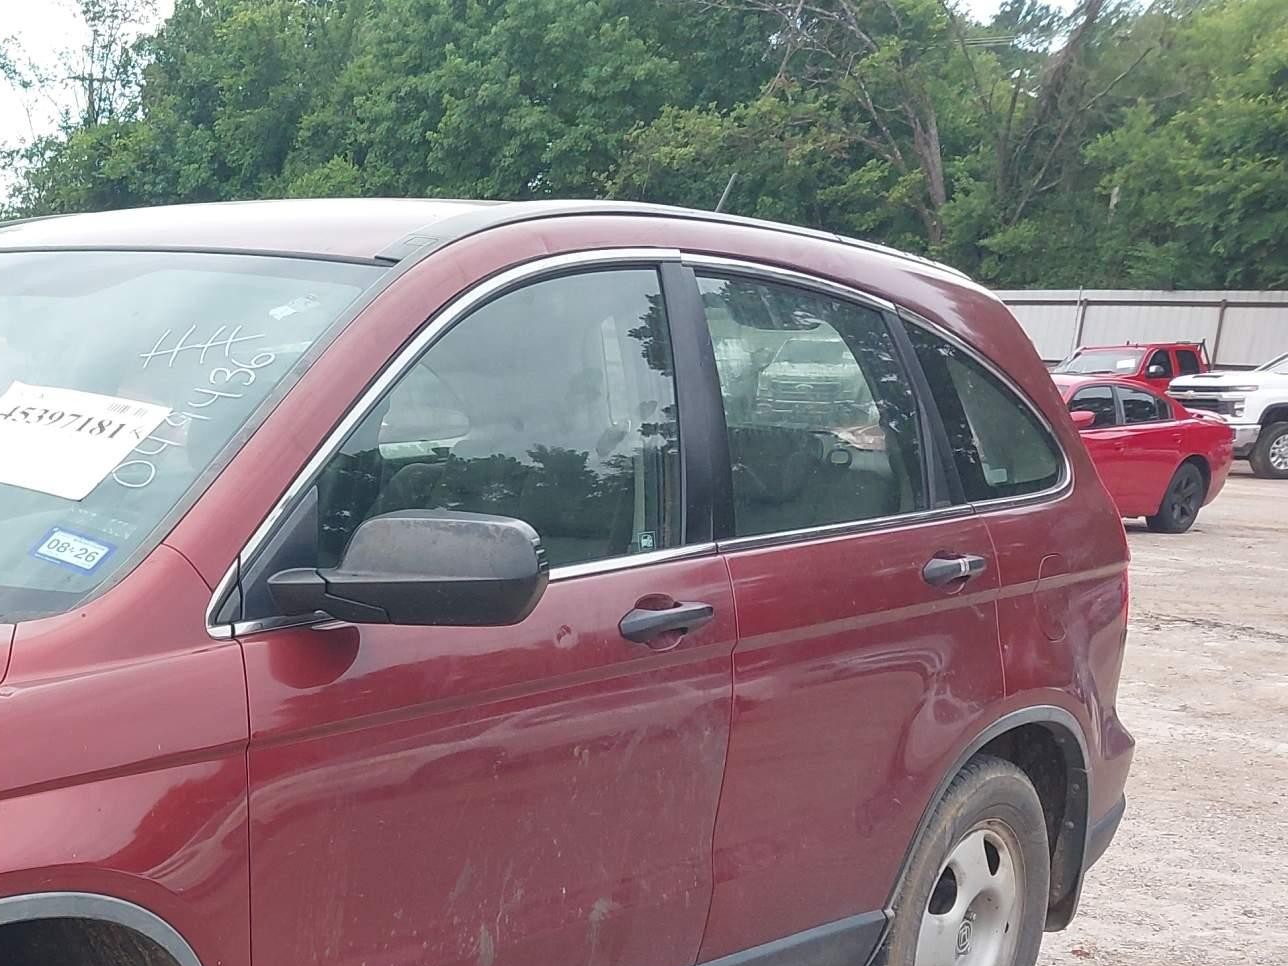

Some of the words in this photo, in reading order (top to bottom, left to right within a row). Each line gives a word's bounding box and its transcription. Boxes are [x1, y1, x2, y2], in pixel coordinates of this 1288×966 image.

[0, 405, 126, 438] 45397181
[47, 538, 71, 553] 08
[73, 547, 99, 563] 26
